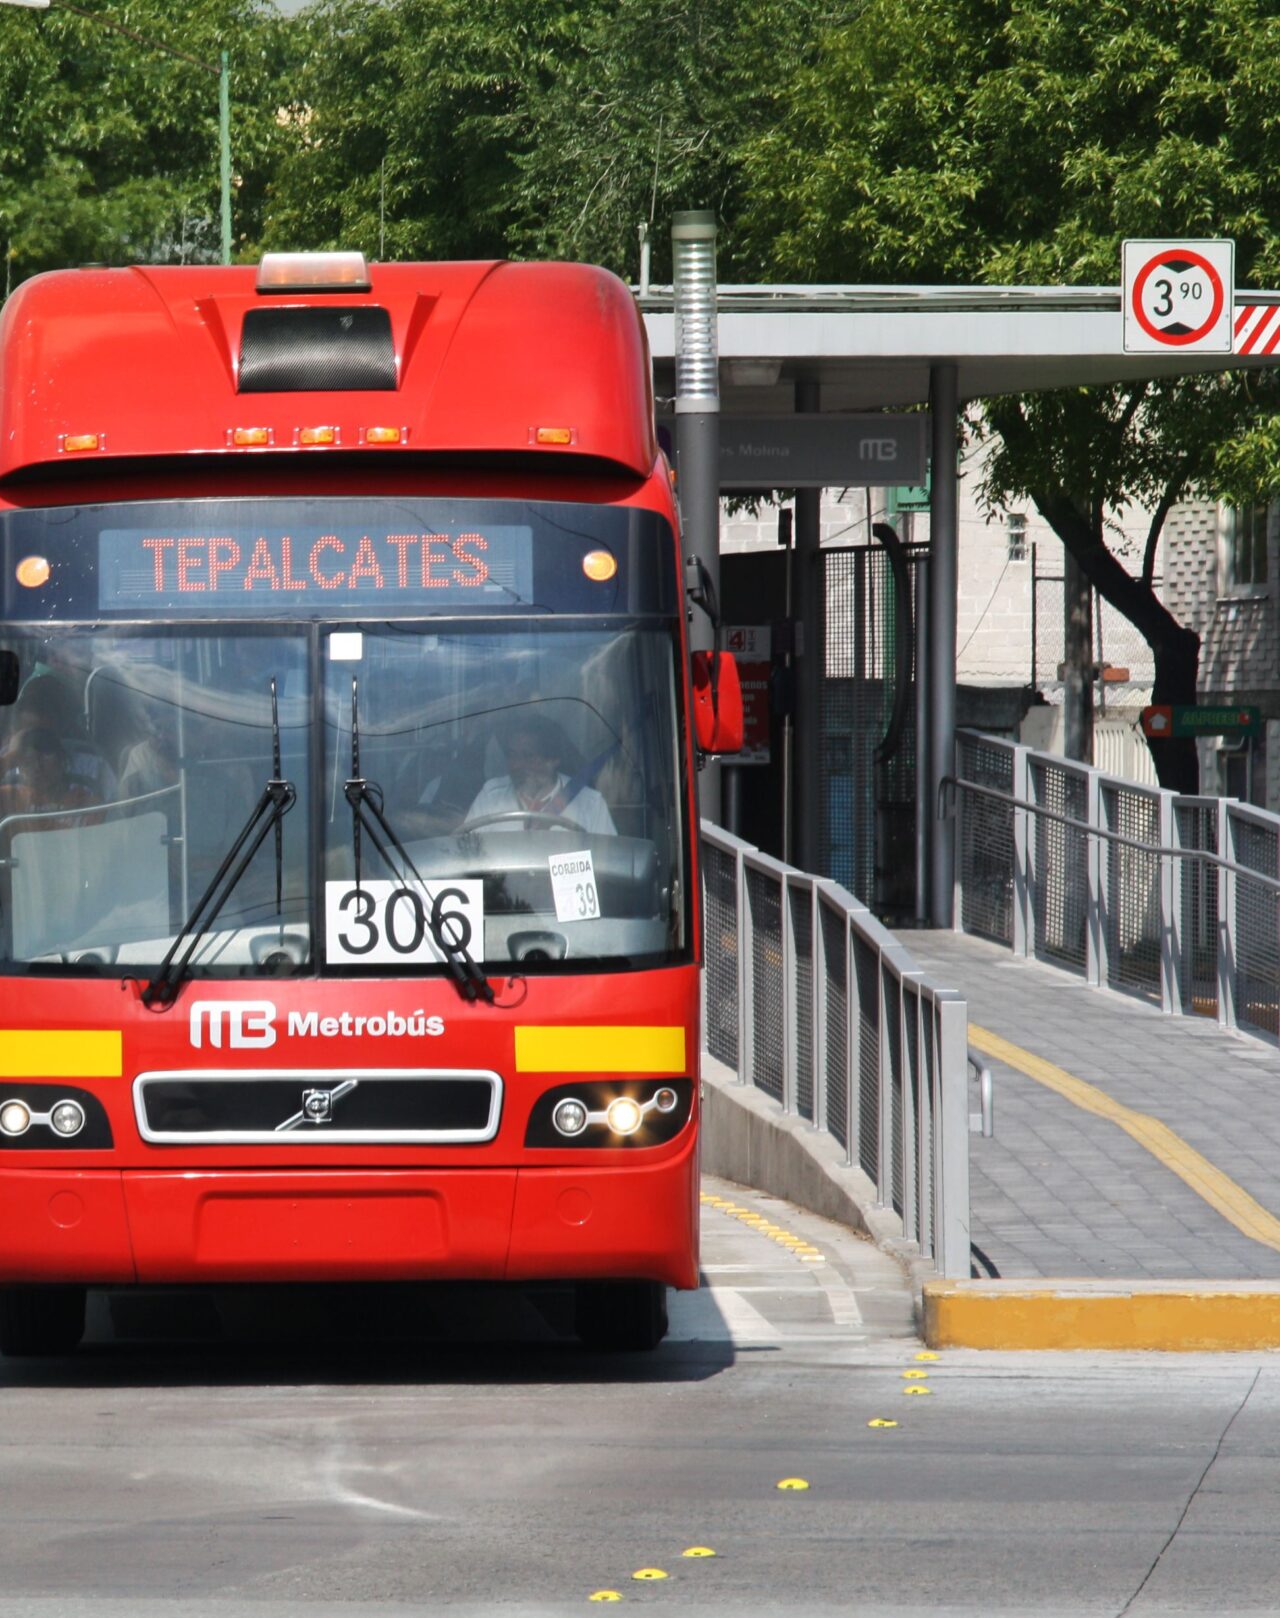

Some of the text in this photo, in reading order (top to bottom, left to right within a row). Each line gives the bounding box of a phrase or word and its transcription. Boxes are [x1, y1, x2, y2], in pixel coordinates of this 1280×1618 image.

[1153, 279, 1202, 317] 3 90
[738, 443, 790, 457] Molina
[141, 533, 489, 592] TEPALCATES
[551, 860, 592, 876] CORRIDA
[575, 882, 597, 917] 39
[338, 888, 472, 955] 306
[190, 1000, 445, 1049] MB Metrobús
